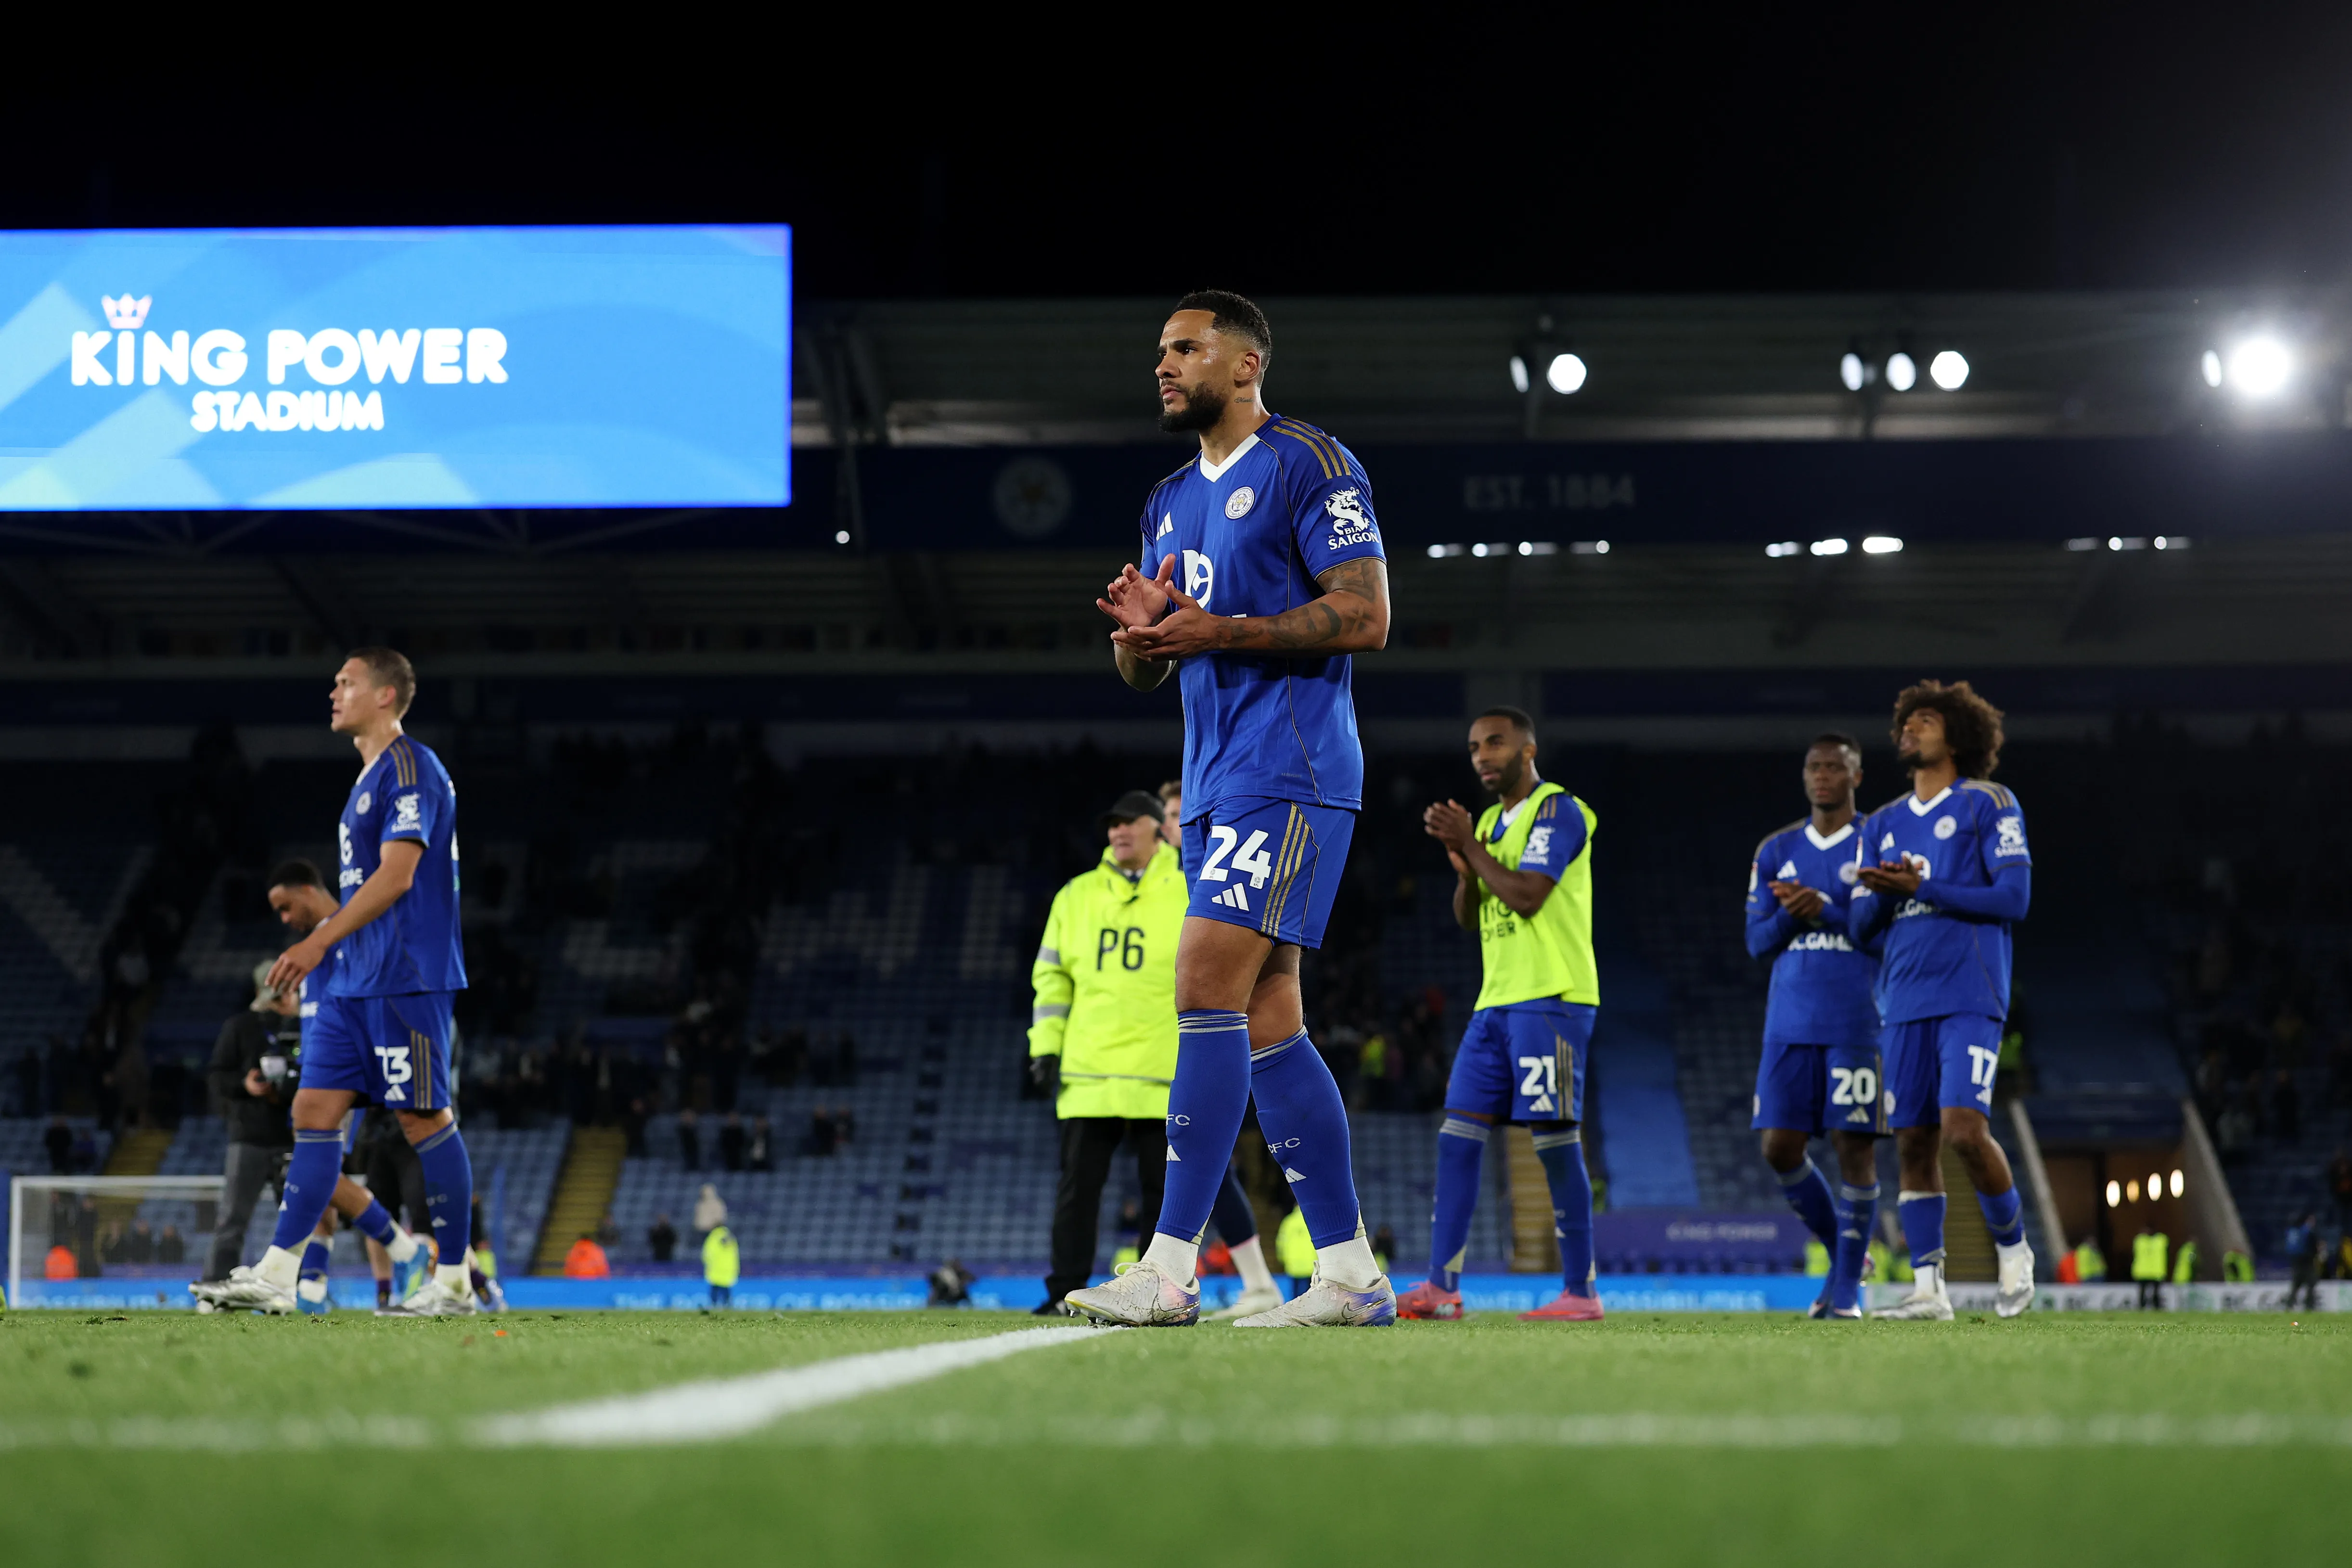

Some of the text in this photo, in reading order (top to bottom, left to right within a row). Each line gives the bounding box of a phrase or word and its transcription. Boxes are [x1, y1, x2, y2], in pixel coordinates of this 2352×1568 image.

[71, 328, 509, 386] KING POWER
[190, 390, 385, 433] STADIUM
[1328, 532, 1380, 551] SAIGON
[1344, 526, 1362, 535] BIA
[1199, 825, 1272, 889] 24
[1096, 926, 1145, 972] P6
[1518, 1054, 1557, 1096] 21
[1831, 1067, 1876, 1105] 20
[1967, 1044, 1998, 1087] 17
